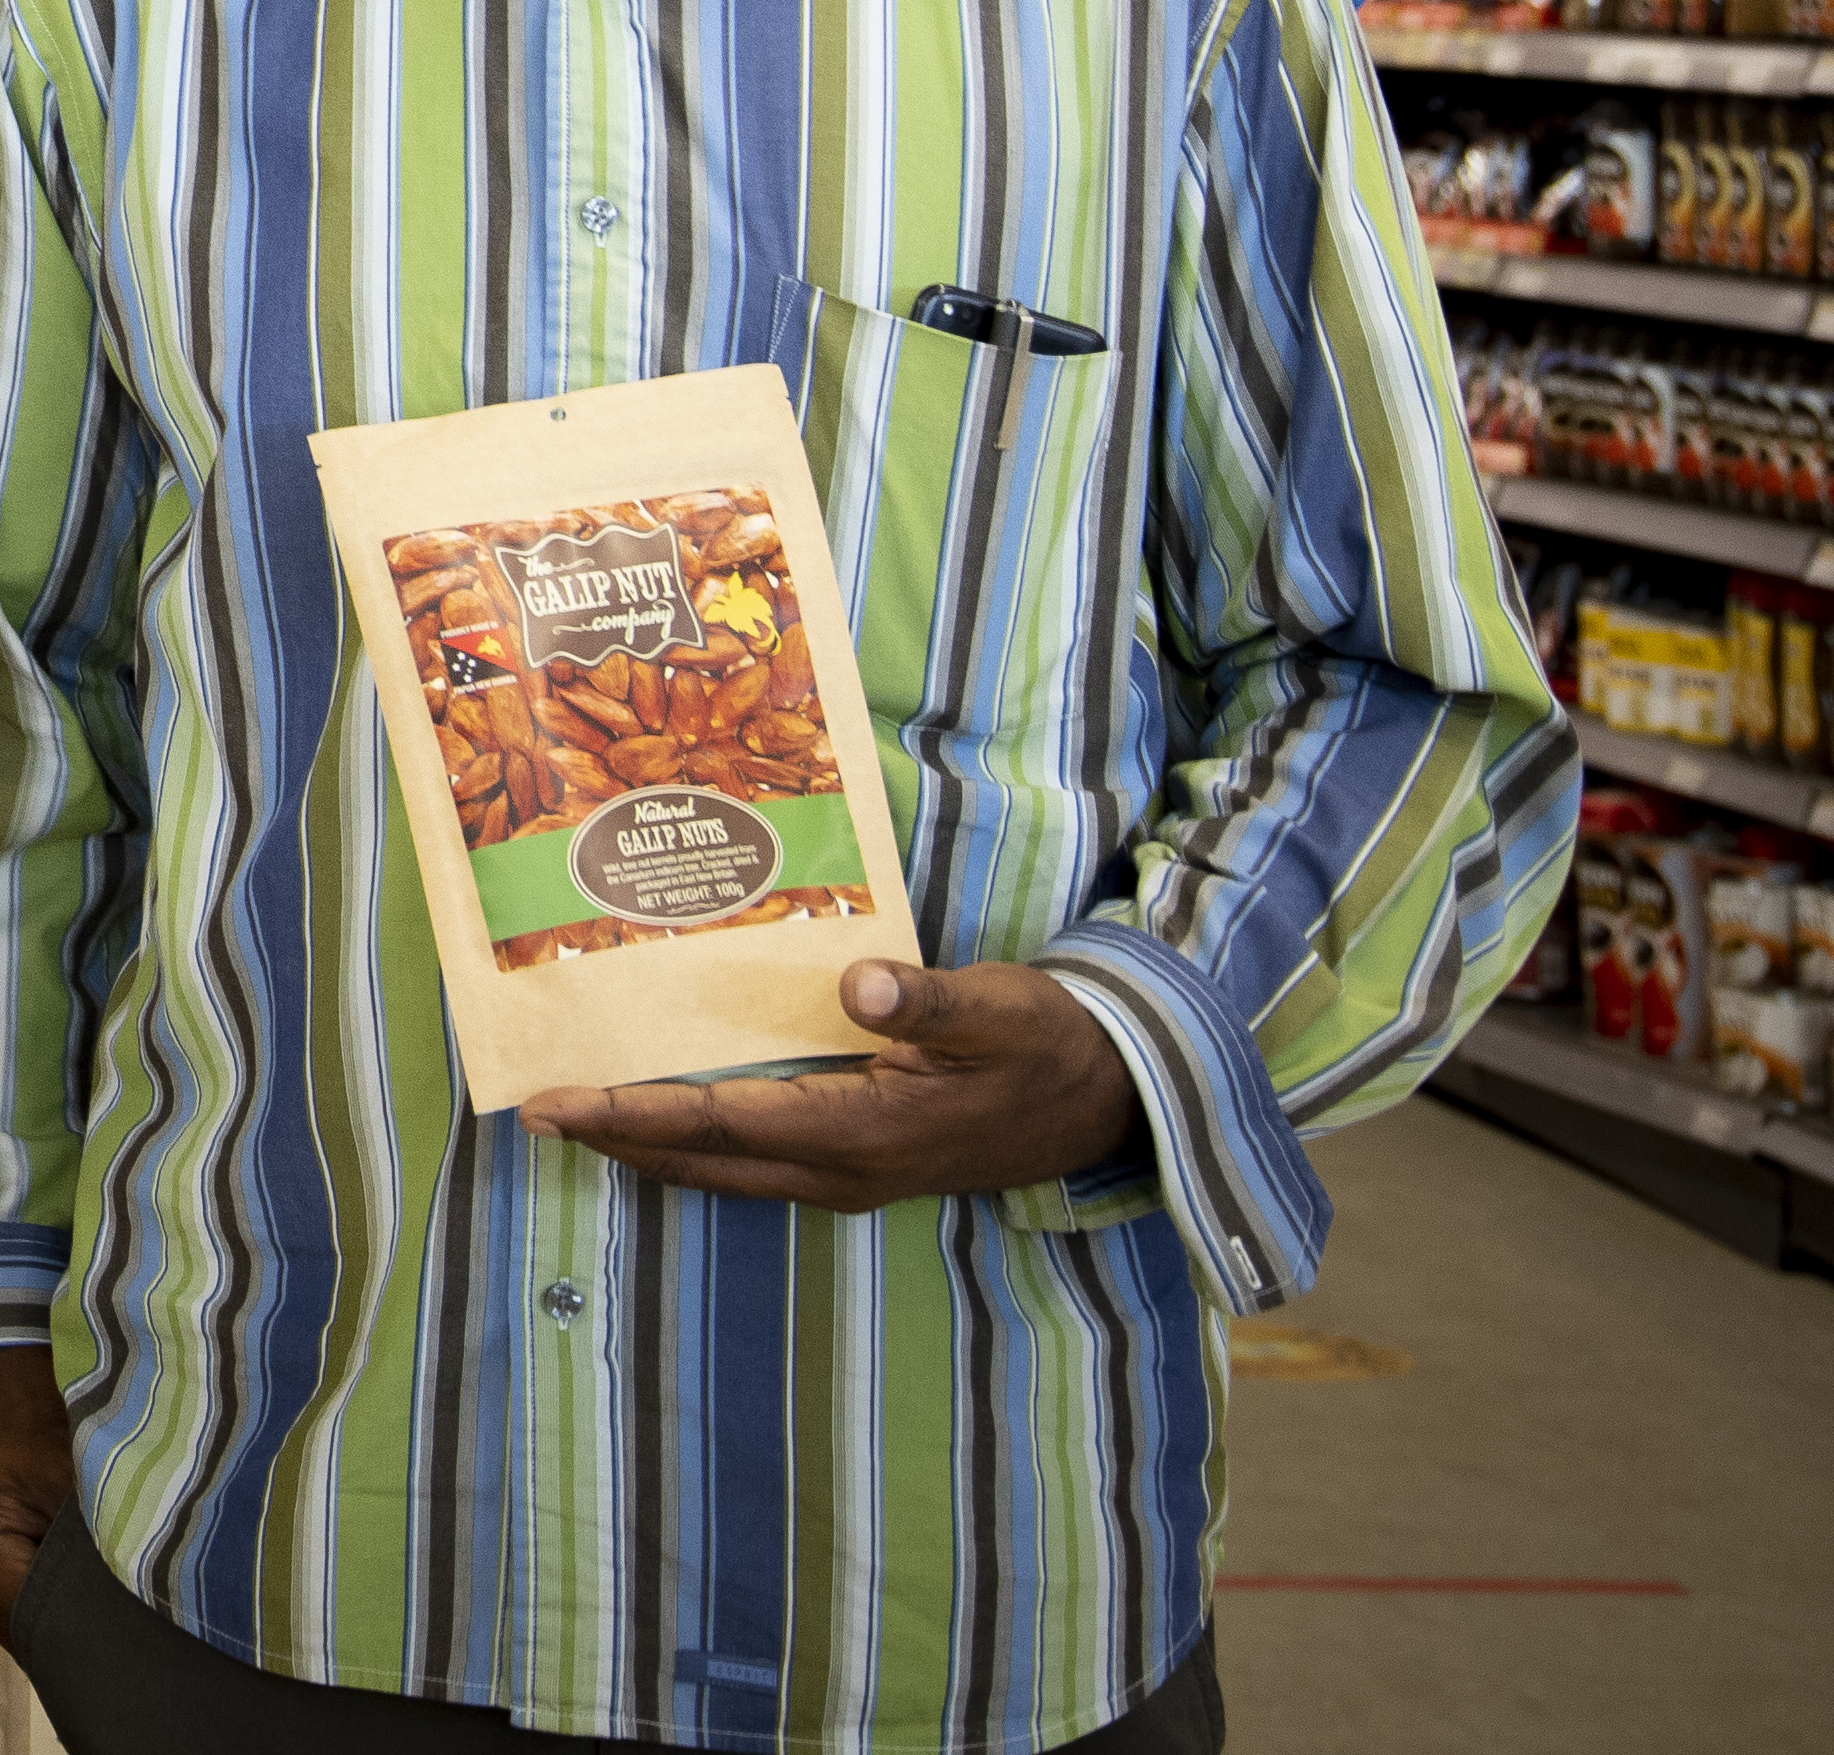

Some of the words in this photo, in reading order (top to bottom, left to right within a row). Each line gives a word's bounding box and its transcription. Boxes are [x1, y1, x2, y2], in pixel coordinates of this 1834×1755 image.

[522, 571, 611, 618] GALIP
[610, 561, 677, 605] NUT
[591, 599, 676, 645] company
[634, 796, 696, 825] Natural
[617, 824, 676, 858] GALIP
[677, 818, 729, 848] NUTS
[637, 895, 662, 910] NET
[716, 882, 745, 898] 100g
